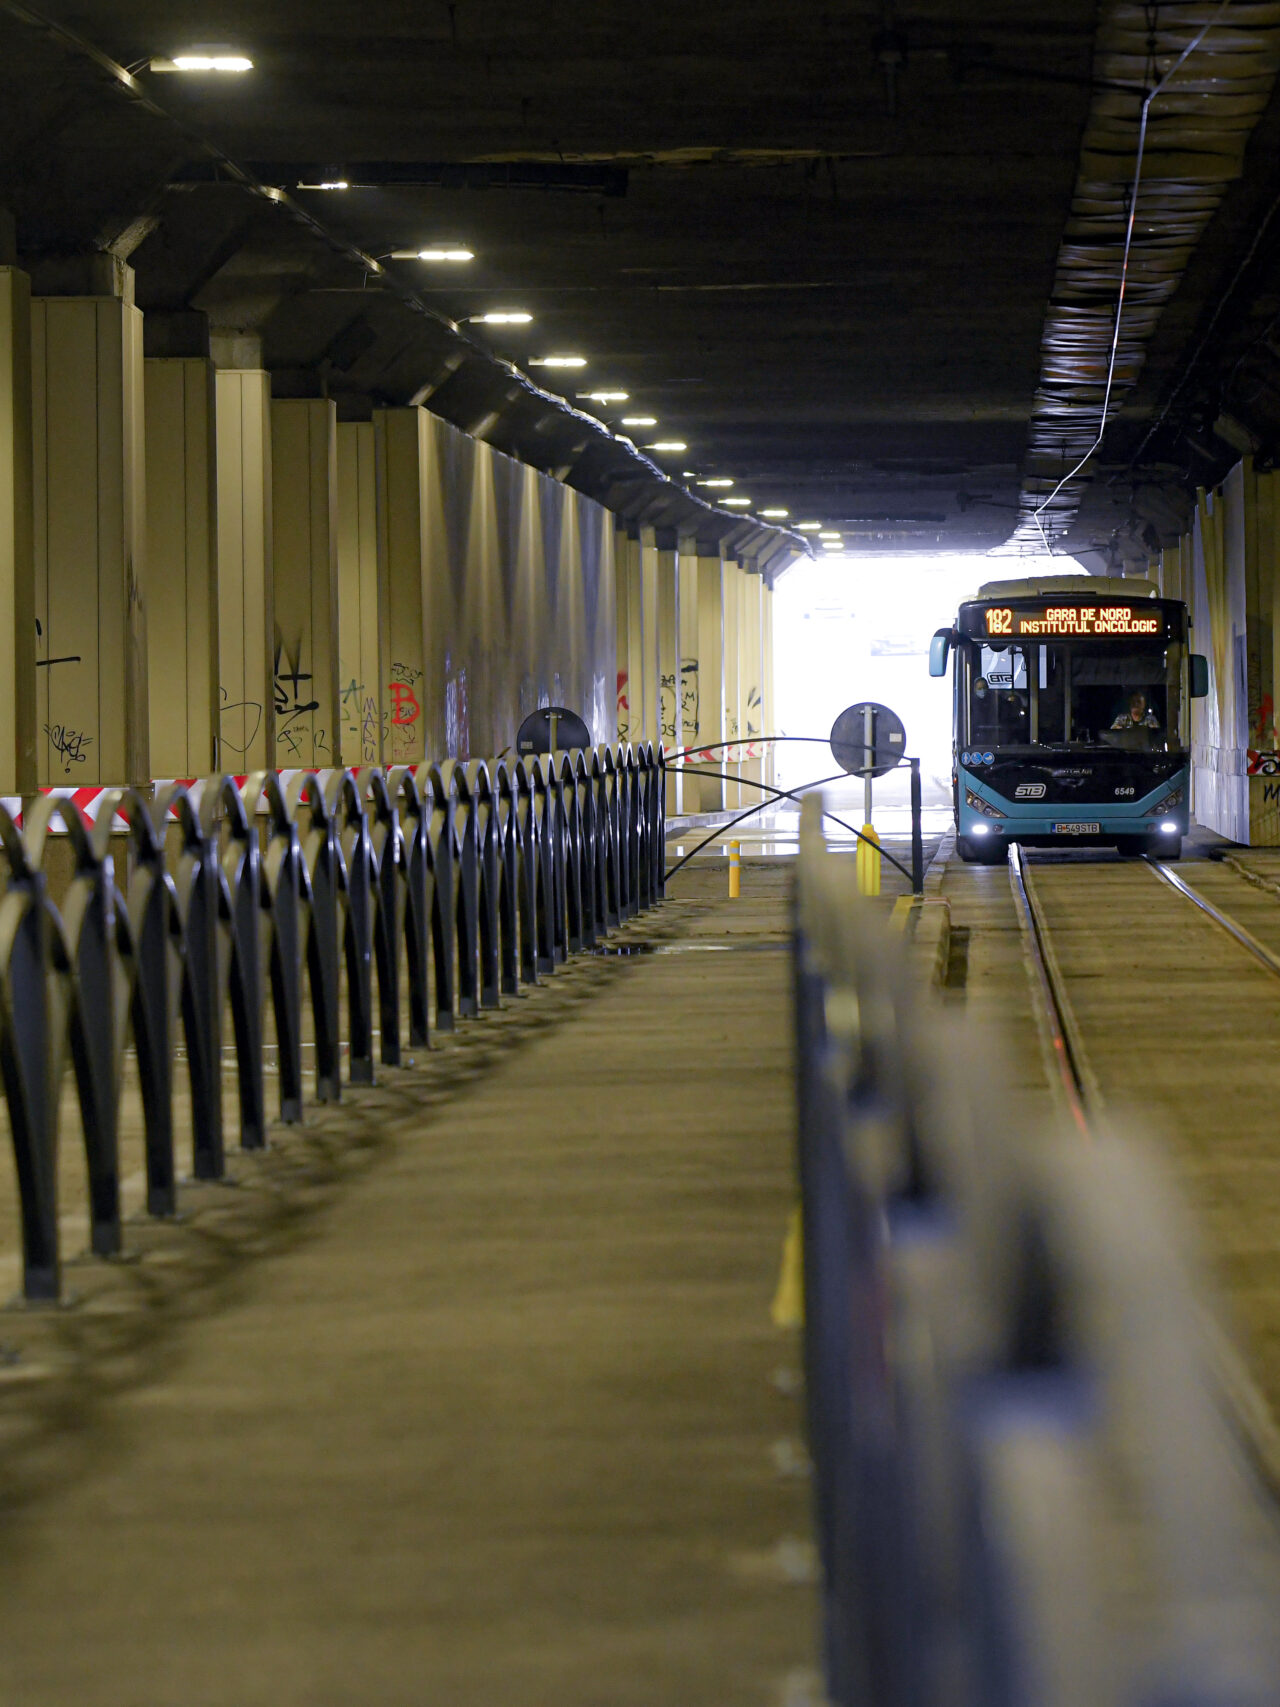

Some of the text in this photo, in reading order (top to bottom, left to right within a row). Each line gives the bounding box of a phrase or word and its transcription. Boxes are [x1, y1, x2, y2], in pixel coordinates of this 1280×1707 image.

[986, 608, 1012, 634] 182
[1046, 608, 1131, 621] GARA DE NORD
[1020, 620, 1157, 633] INSTITUTUL ONCOLOGIC
[1015, 785, 1044, 797] STB
[1114, 787, 1135, 795] 6549
